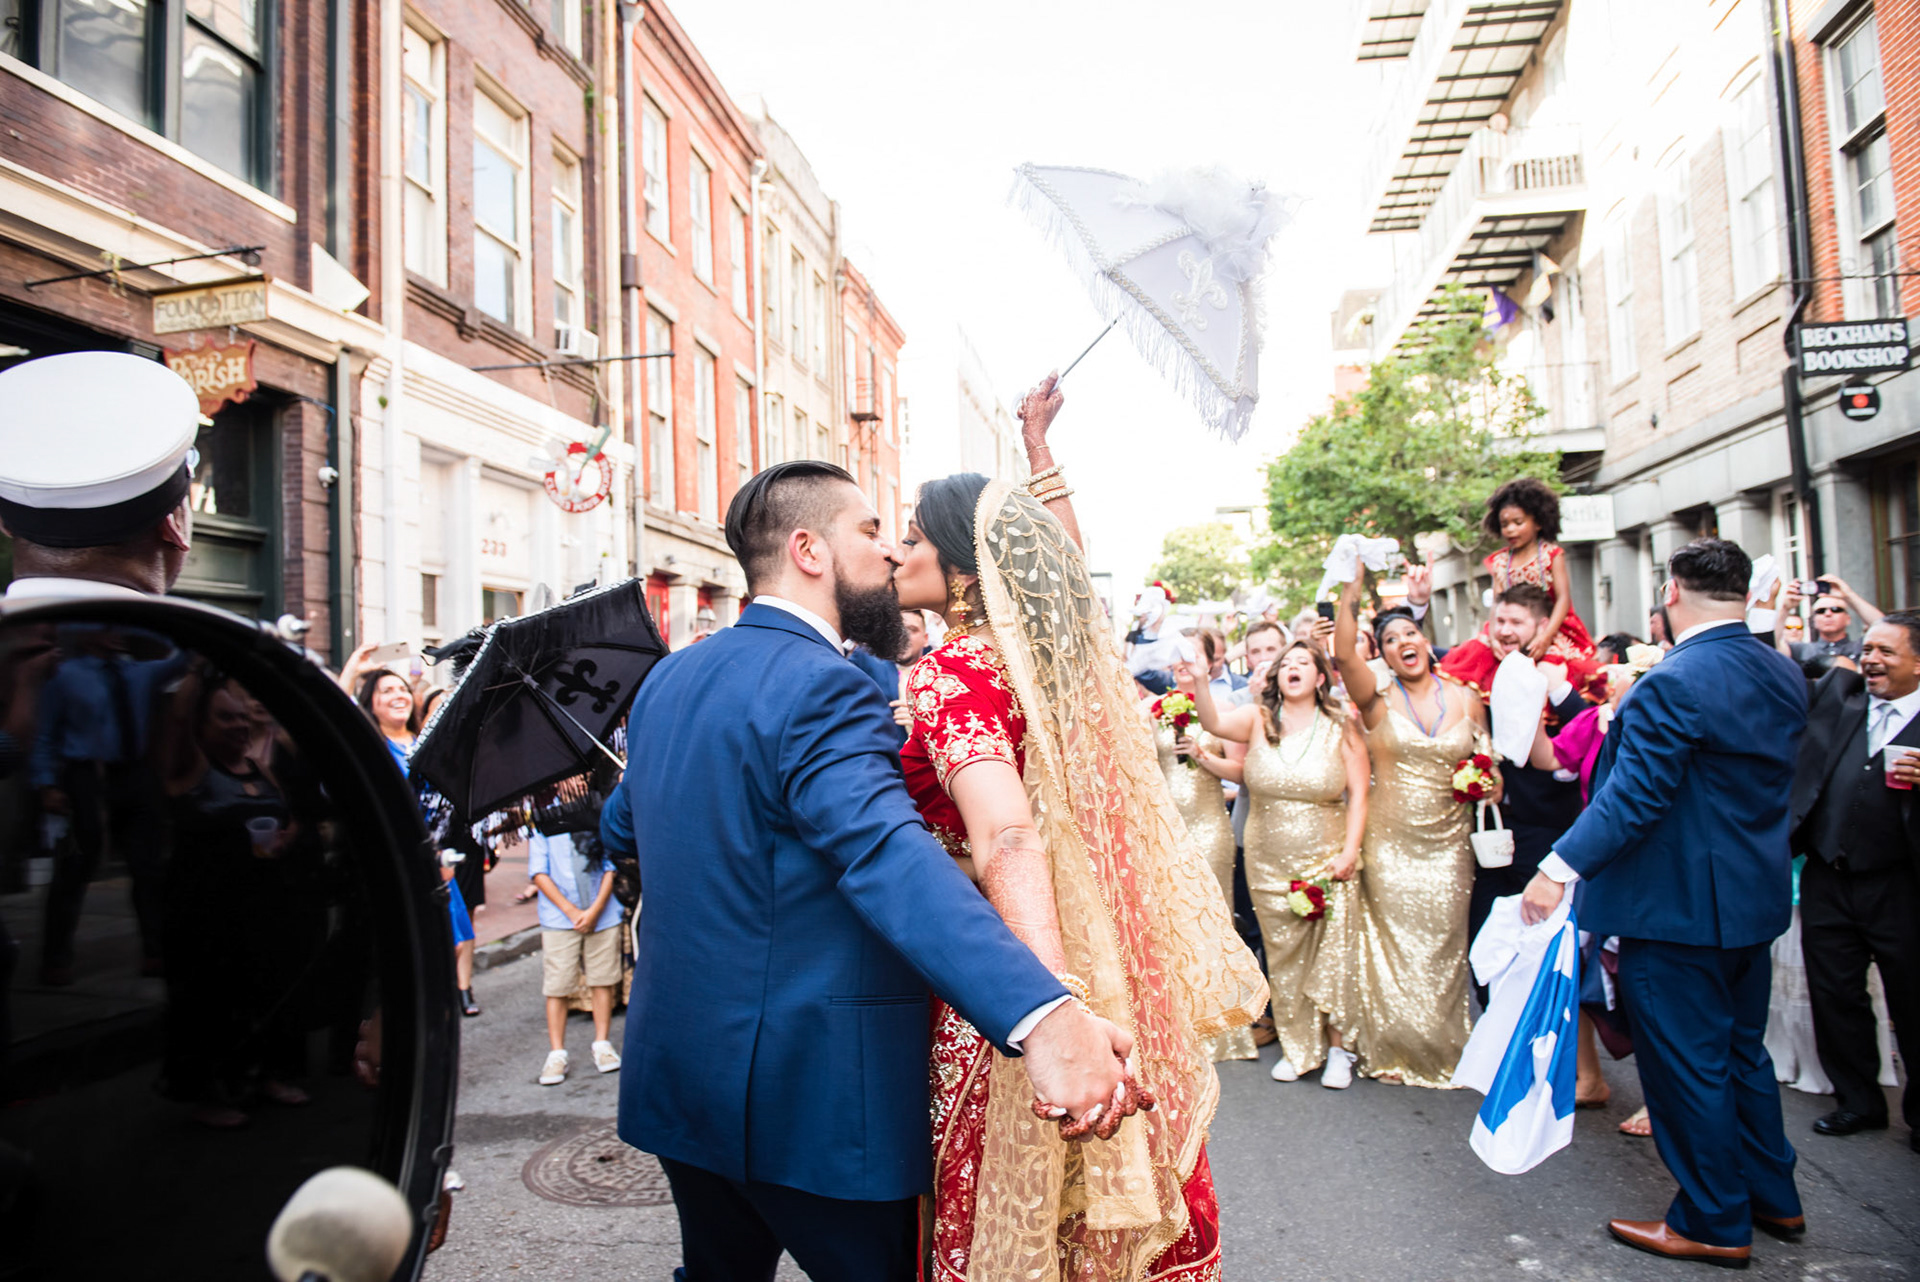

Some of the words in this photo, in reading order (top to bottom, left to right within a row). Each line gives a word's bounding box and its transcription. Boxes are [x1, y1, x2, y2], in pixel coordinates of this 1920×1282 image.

[156, 289, 265, 319] FOUNDATION
[1801, 323, 1906, 348] BECKHAM'S
[1803, 346, 1909, 372] BOOKSHOP
[169, 354, 248, 395] PARISH
[481, 538, 507, 558] 233
